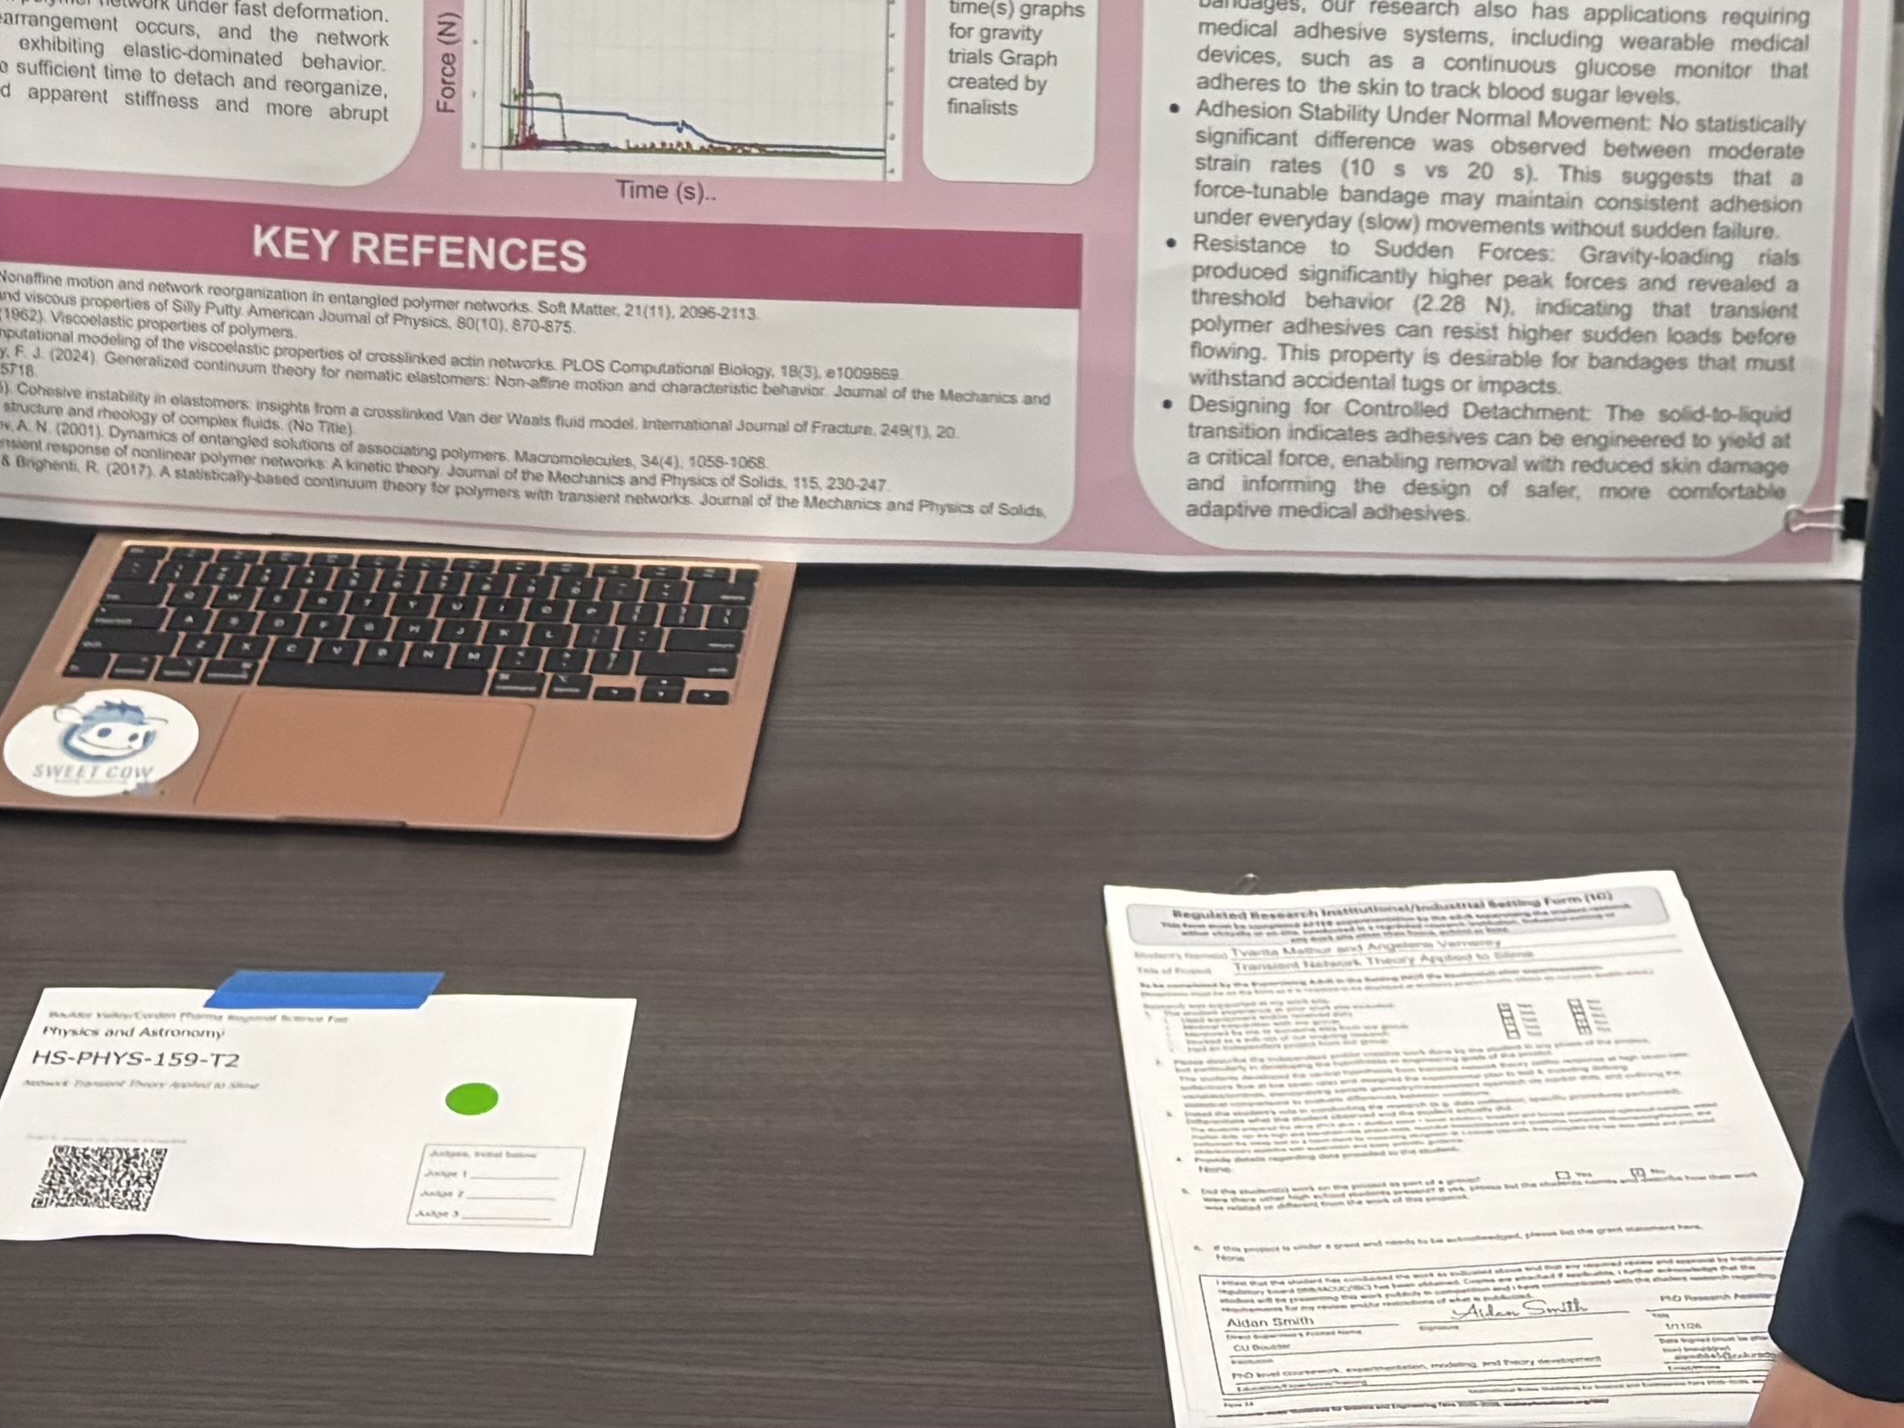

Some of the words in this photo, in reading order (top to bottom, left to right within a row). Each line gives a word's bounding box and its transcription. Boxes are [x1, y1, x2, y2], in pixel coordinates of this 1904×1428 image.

[253, 223, 340, 262] KEY
[353, 232, 587, 274] REFENCES
[32, 764, 100, 779] SWEET
[106, 765, 154, 779] COW
[31, 1049, 241, 1069] HS-PHYS-159-T2
